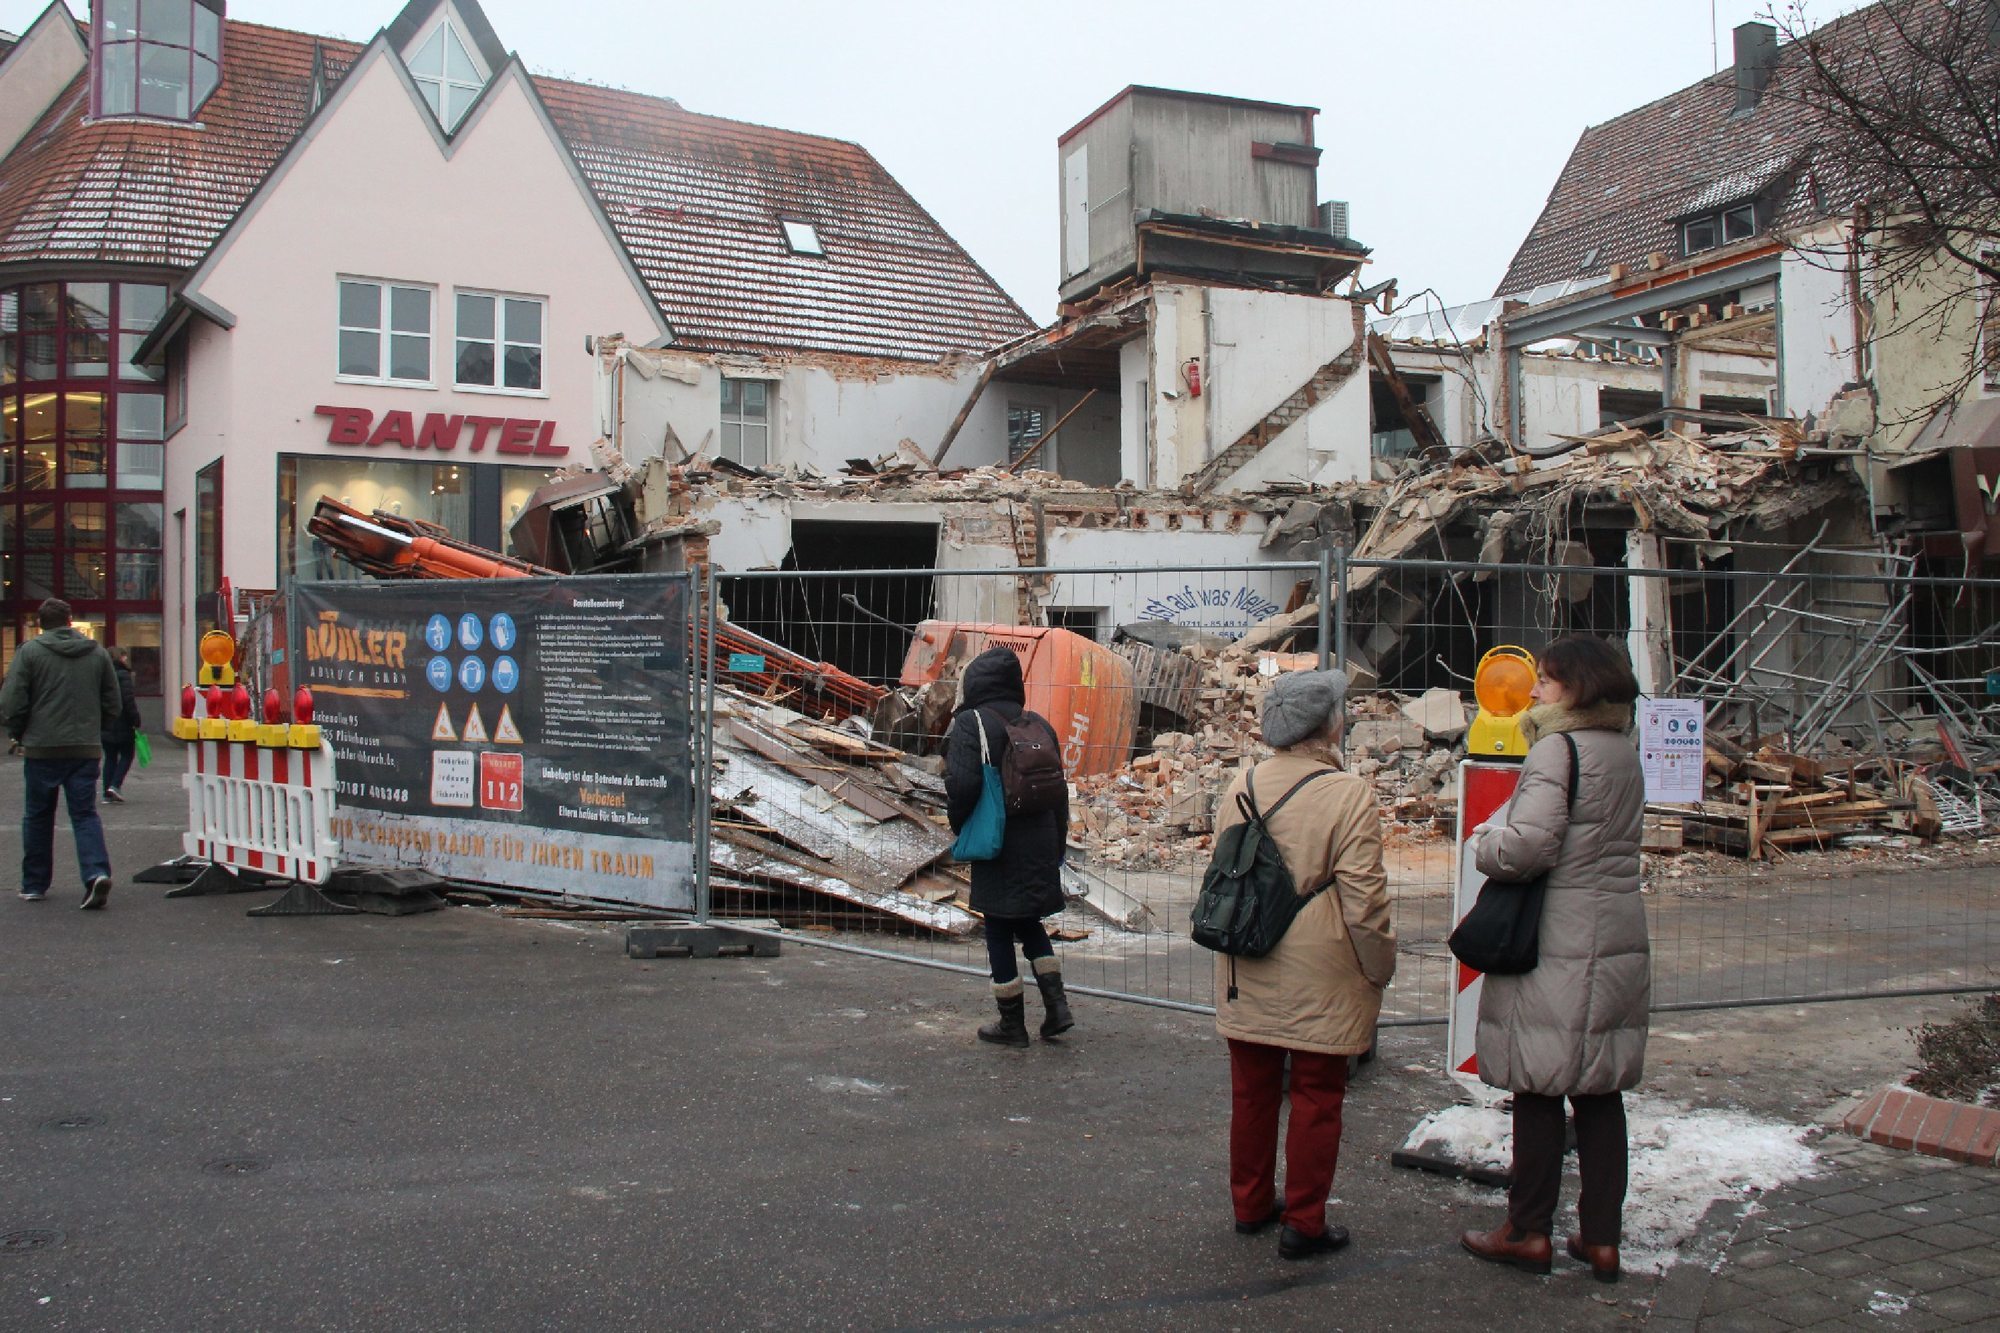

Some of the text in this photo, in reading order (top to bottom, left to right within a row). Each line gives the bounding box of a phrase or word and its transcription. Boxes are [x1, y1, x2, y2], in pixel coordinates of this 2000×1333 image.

[314, 405, 570, 457] BANTEL
[1167, 584, 1199, 612] auf
[1196, 588, 1231, 608] was
[1229, 586, 1281, 622] Neue
[541, 766, 572, 784] Unbefugt
[572, 770, 581, 782] ist
[581, 770, 594, 784] das
[623, 774, 634, 787] der
[635, 774, 668, 789] Baustelle
[487, 781, 519, 803] 112
[578, 786, 627, 808] Verboten!
[558, 805, 578, 819] Eltern
[578, 806, 598, 821] haften
[598, 809, 610, 822] für
[610, 811, 626, 824] ihre
[356, 820, 432, 853] SCHAFFEN
[437, 831, 486, 857] RAUM
[491, 832, 525, 863] FÜR
[529, 841, 585, 871] IHREN
[589, 848, 656, 881] TRAUM
